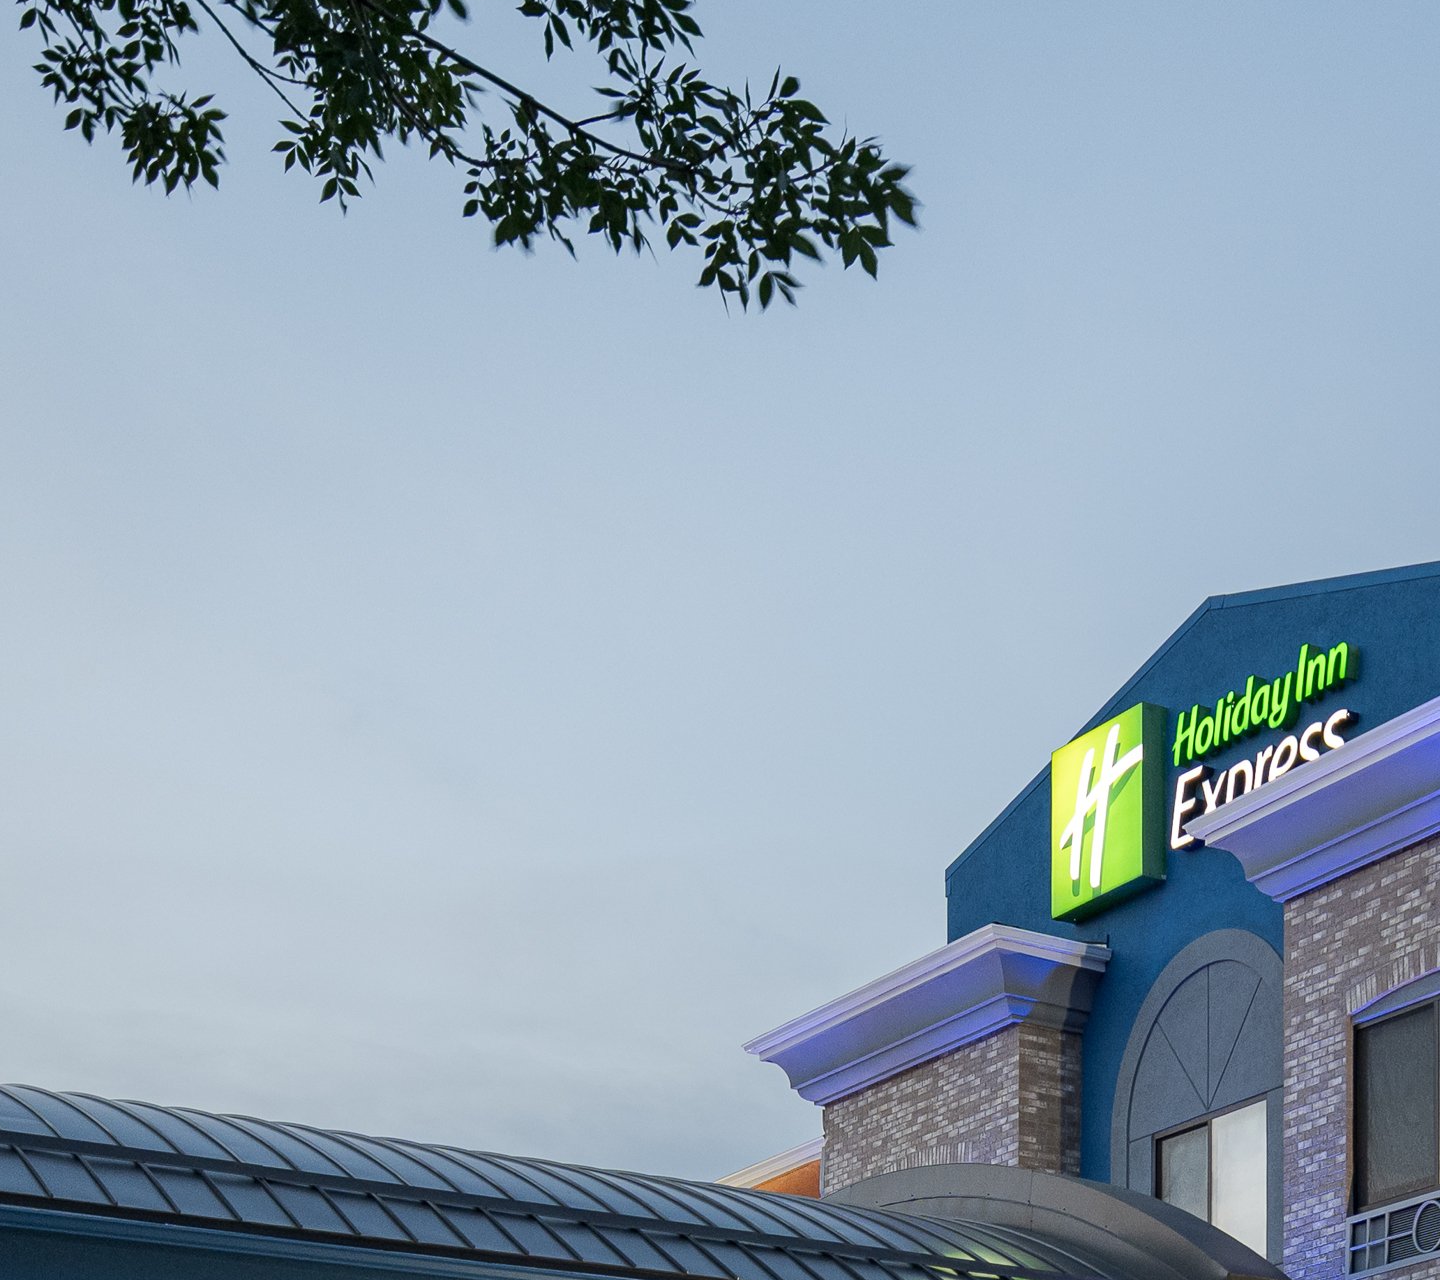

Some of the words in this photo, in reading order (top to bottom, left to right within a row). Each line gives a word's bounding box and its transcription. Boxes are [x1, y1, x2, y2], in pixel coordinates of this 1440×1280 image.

[1171, 671, 1292, 767] Holiday
[1295, 641, 1349, 703] Inn
[1170, 708, 1349, 850] Express
